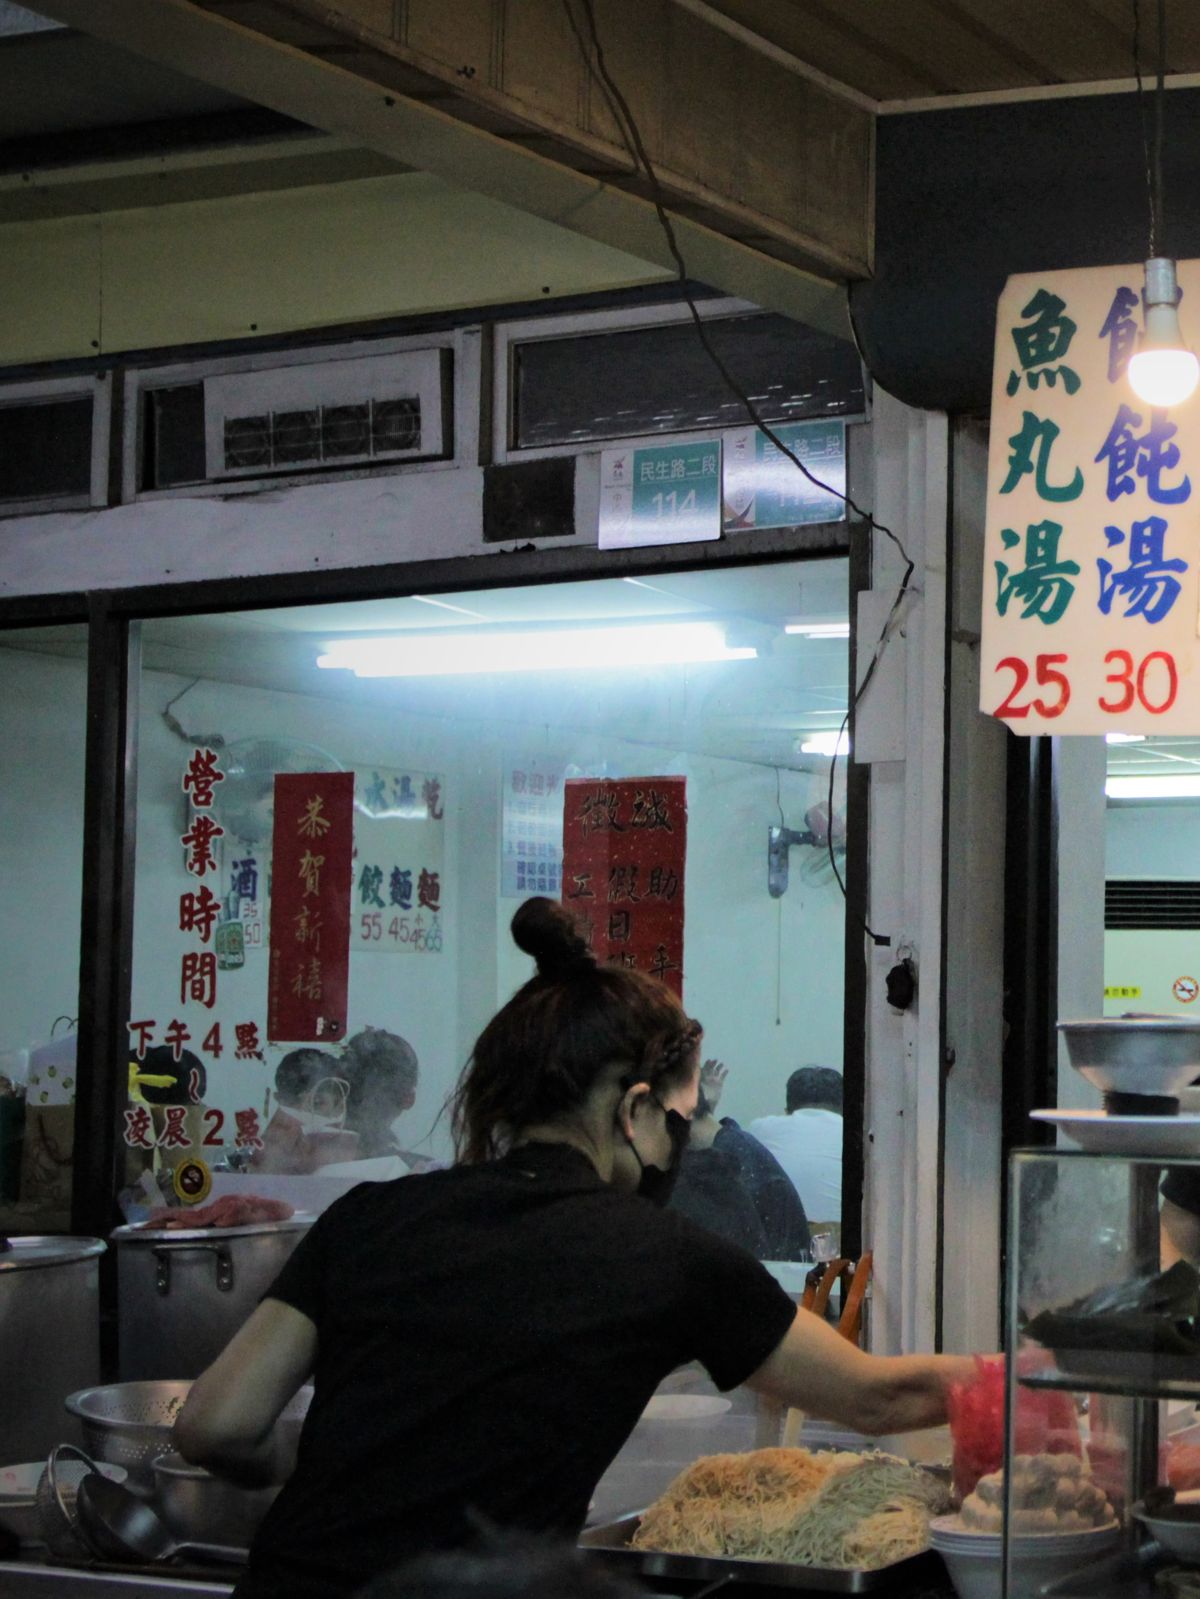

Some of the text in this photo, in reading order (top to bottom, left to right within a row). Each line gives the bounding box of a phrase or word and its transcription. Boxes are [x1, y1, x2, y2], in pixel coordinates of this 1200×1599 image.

[640, 454, 717, 481] 民生路二段
[995, 288, 1084, 625] 魚丸湯
[652, 489, 698, 520] 114
[993, 654, 1071, 718] 25
[1098, 650, 1179, 715] 30
[180, 749, 223, 1009] 營業時間
[291, 794, 331, 1001] 恭賀新禧
[361, 912, 382, 940] 55
[388, 916, 410, 943] 45
